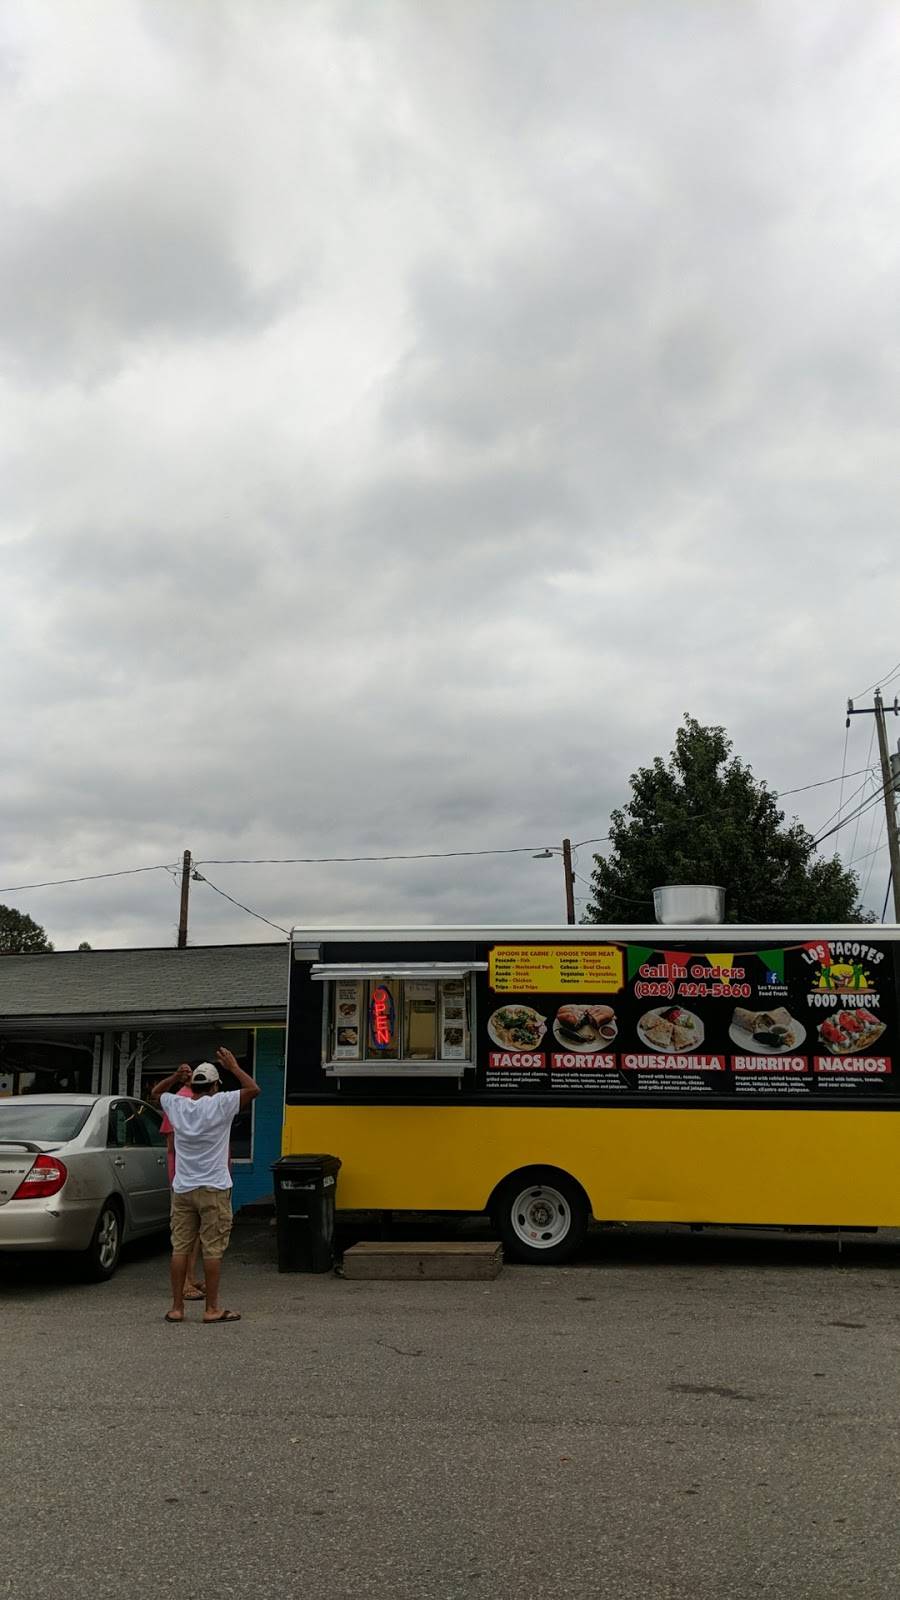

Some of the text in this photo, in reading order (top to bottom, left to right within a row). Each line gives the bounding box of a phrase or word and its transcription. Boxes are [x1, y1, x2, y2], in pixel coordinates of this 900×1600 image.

[801, 942, 885, 965] LOS TACOTES
[639, 963, 746, 979] Call in Orders
[634, 981, 751, 999] (828) 424-5860
[806, 994, 880, 1008] FOOD TRUCK
[372, 988, 391, 1045] OPEN
[492, 1054, 542, 1067] TACOS
[554, 1055, 614, 1068] TORTAS
[624, 1055, 722, 1070] QUESADILLA
[734, 1056, 805, 1071] BURRITO
[818, 1057, 887, 1072] NACHOS
